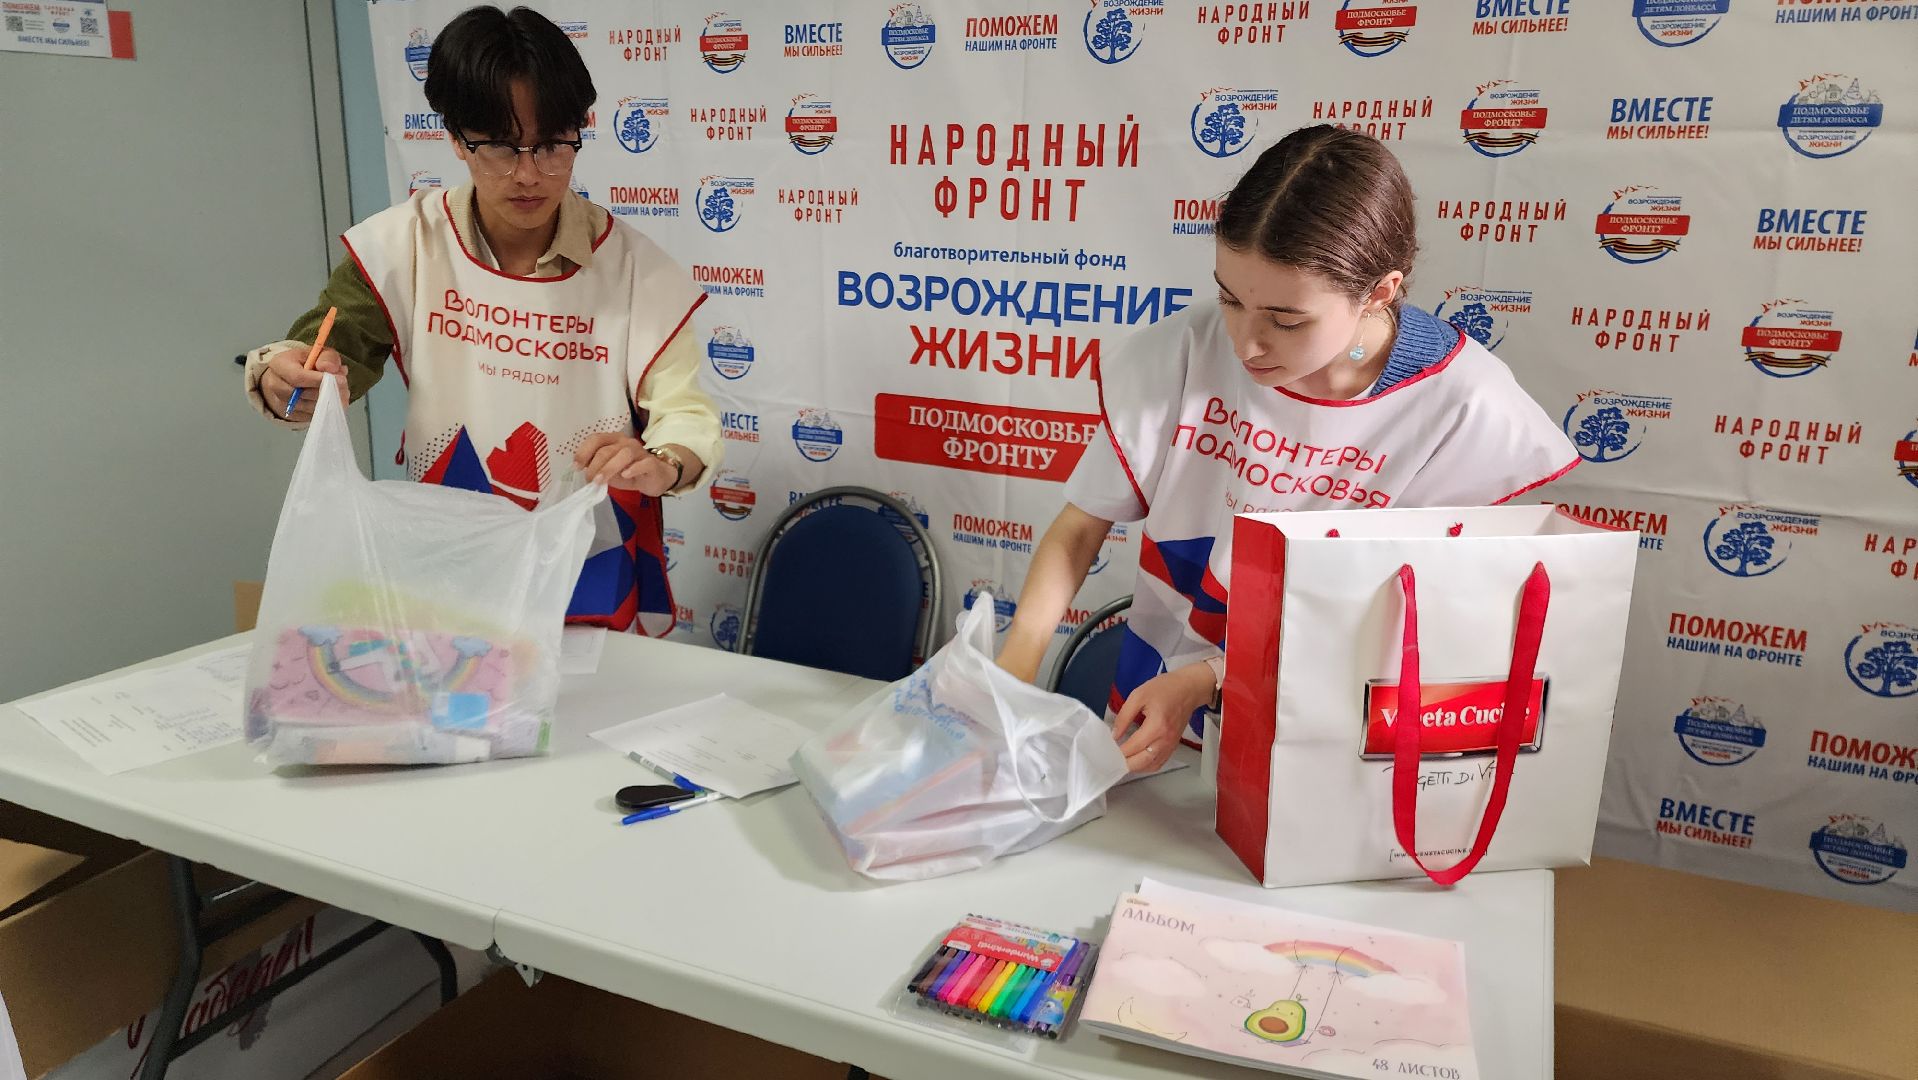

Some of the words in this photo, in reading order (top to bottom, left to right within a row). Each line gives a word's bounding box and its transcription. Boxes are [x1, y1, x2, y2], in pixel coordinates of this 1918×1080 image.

[1129, 8, 1164, 16] ЖИЗНИ
[1476, 0, 1570, 19] ВМЕСТЕ
[1776, 8, 1836, 23] НАШИМ
[1841, 7, 1861, 21] НА
[1866, 5, 1918, 20] ФРОНТ
[609, 25, 681, 45] НАРОДНЫЙ
[784, 23, 843, 44] ВМЕСТЕ
[966, 15, 1058, 37] ПОМОЖЕМ
[1217, 25, 1286, 44] ФРОНТ
[1473, 20, 1497, 35] МЫ
[1501, 18, 1568, 34] СИЛЬНЕЕ!
[623, 46, 669, 62] ФРОНТ
[784, 46, 799, 57] МЫ
[801, 45, 843, 57] СИЛЬНЕЕ!
[965, 41, 1002, 52] НАШИМ
[1005, 40, 1018, 51] НА
[1021, 38, 1057, 50] ФРОНТЕ
[1215, 94, 1278, 102] ВОЗРОЖДЕНИЕ
[1313, 96, 1433, 120] НАРОДНЫЙ
[691, 105, 767, 124] НАРОДНЫЙ
[1611, 97, 1713, 122] ВМЕСТЕ
[706, 125, 753, 141] ФРОНТ
[1607, 125, 1632, 139] МЫ
[1637, 125, 1709, 139] СИЛЬНЕЕ!
[890, 114, 1139, 171] НАРОДНЫЙ
[610, 187, 679, 205] ПОМОЖЕМ
[779, 189, 858, 206] НАРОДНЫЙ
[934, 176, 1086, 222] ФРОНТ
[612, 206, 639, 215] НАШИМ
[640, 207, 650, 216] НА
[794, 208, 842, 223] ФРОНТ
[1438, 199, 1566, 222] НАРОДНЫЙ
[1758, 208, 1867, 235] ВМЕСТЕ
[1460, 223, 1538, 242] ФРОНТ
[1753, 236, 1781, 250] МЫ
[1786, 236, 1862, 252] СИЛЬНЕЕ!
[894, 242, 1069, 266] благотворительный
[1074, 249, 1126, 270] фонд
[693, 265, 764, 286] ПОМОЖЕМ
[723, 286, 732, 295] НА
[735, 287, 764, 297] ФРОНТЕ
[838, 270, 1193, 327] ВОЗРОЖДЕНИЕ
[1460, 294, 1532, 304] ВОЗРОЖДЕНИЕ
[1490, 303, 1531, 313] ЖИЗНИ
[1571, 307, 1711, 332] НАРОДНЫЙ
[1594, 330, 1679, 352] ФРОНТ
[910, 325, 1100, 381] ЖИЗНИ
[502, 368, 560, 386] РЯДОМ
[1594, 397, 1672, 409] ВОЗРОЖДЕНИЕ
[721, 411, 758, 431] МЕСТЕ
[1626, 408, 1671, 419] ЖИЗНИ
[909, 405, 1097, 446] ПОДМОСКОВЬЕ
[1715, 415, 1862, 444] НАРОДНЫЙ
[942, 437, 1057, 470] ФРОНТУ
[1739, 440, 1829, 464] ФРОНТ
[954, 514, 1032, 541] ПОМОЖЕМ
[1737, 512, 1820, 526] ВОЗРОЖДЕНИЕ
[1770, 524, 1818, 536] ЖИЗНИ
[953, 532, 984, 545] НАШИМ
[986, 539, 997, 548] НА
[1000, 540, 1032, 554] ФРОНТЕ
[1640, 537, 1664, 550] НТЕ
[1669, 613, 1807, 651] ПОМОЖЕМ
[1667, 636, 1720, 654] НАШИМ
[1724, 645, 1742, 659] НА
[1746, 648, 1802, 667] ФРОНТЕ
[1381, 705, 1456, 728] Veta
[1808, 730, 1918, 769] ПОМОЖ
[1808, 755, 1865, 775] НАШИМ
[1869, 766, 1888, 779] НА
[1660, 798, 1755, 835] ВМЕСТЕ
[1656, 819, 1681, 834] МЫ
[1684, 828, 1752, 848] СИЛЬНЕЕ!
[1122, 907, 1195, 935] АЛЬБОМ
[1372, 1058, 1389, 1071] 48
[1398, 1062, 1460, 1080] ЛИСТОВ
